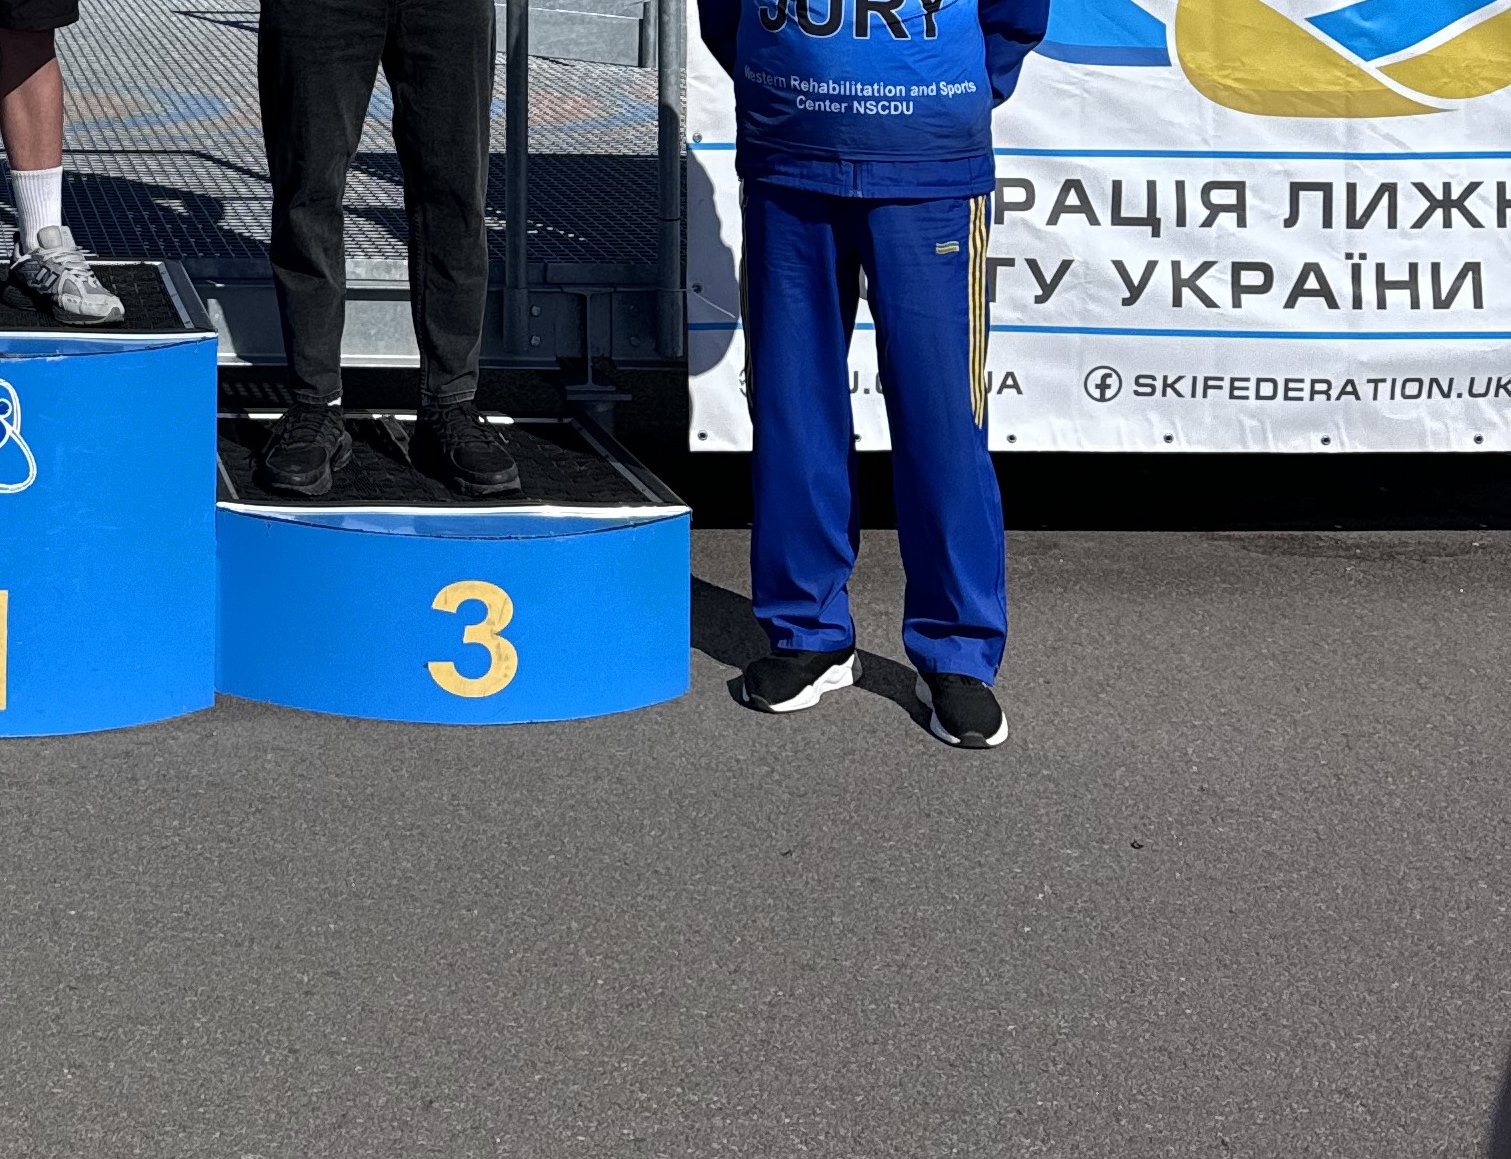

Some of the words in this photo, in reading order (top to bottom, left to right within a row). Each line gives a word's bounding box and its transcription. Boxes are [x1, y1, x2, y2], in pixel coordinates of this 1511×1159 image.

[744, 64, 787, 89] Western
[790, 74, 906, 97] Rehabilitation
[910, 81, 937, 97] and
[939, 79, 977, 99] Sports
[796, 95, 848, 113] Center
[853, 100, 914, 115] NSCDU
[993, 177, 1247, 238] РАЦІЯ
[1121, 252, 1484, 311] УКРАЇНИ
[1133, 374, 1511, 402] SKIFEDERATION.UK
[427, 580, 518, 698] 3
